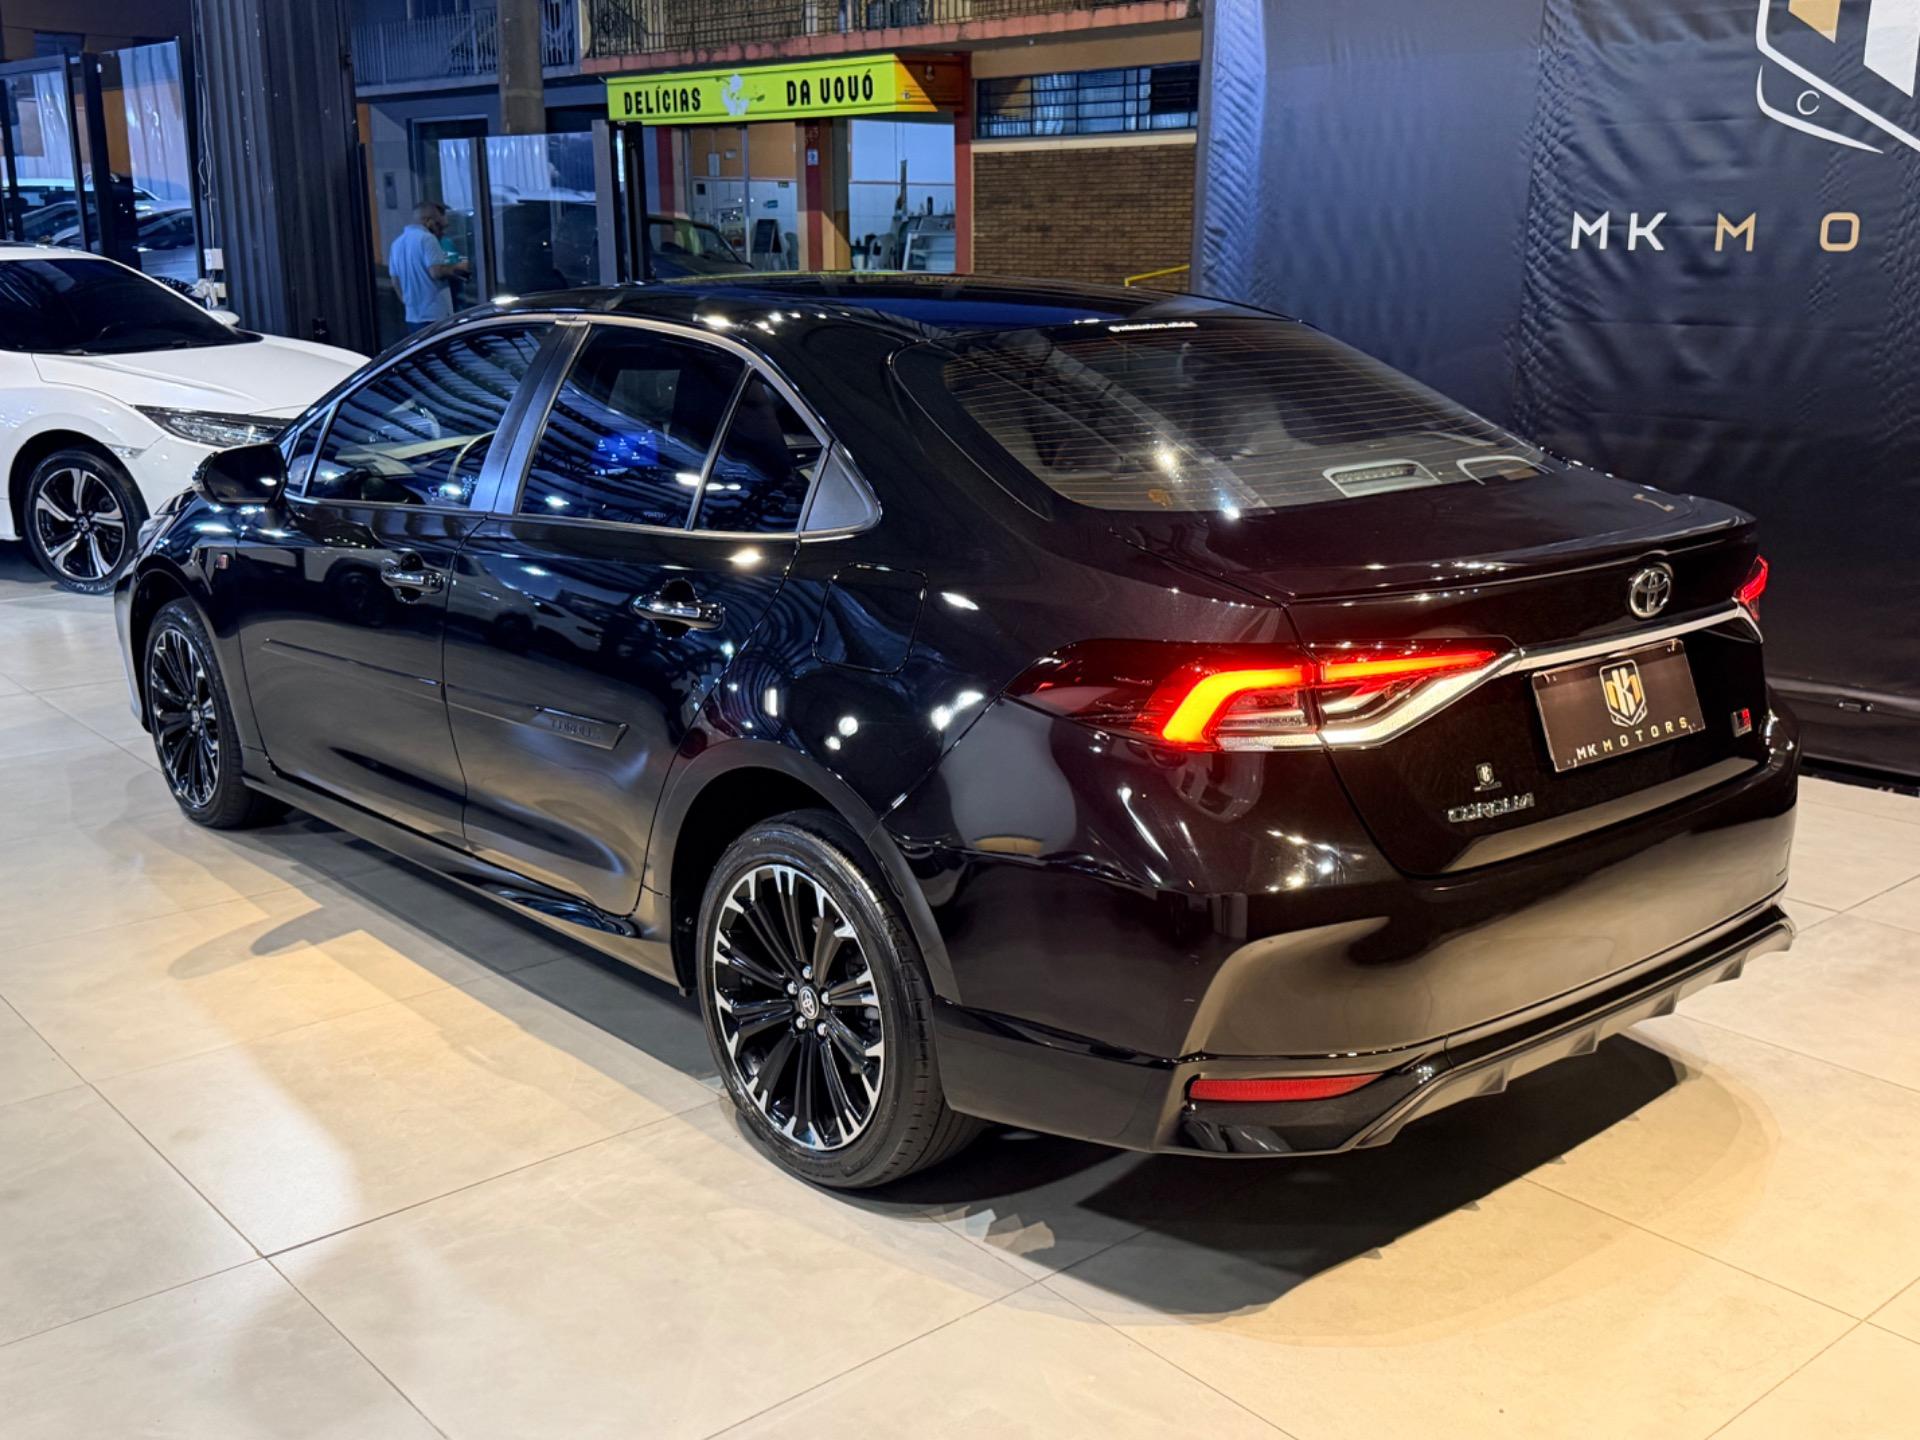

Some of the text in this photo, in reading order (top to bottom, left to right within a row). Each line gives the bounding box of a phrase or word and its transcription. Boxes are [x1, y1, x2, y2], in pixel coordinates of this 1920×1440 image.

[624, 86, 701, 115] DELÍCIAS
[786, 79, 811, 107] DA
[1570, 211, 1667, 251] MK
[1576, 717, 1689, 761] MK MOTORS
